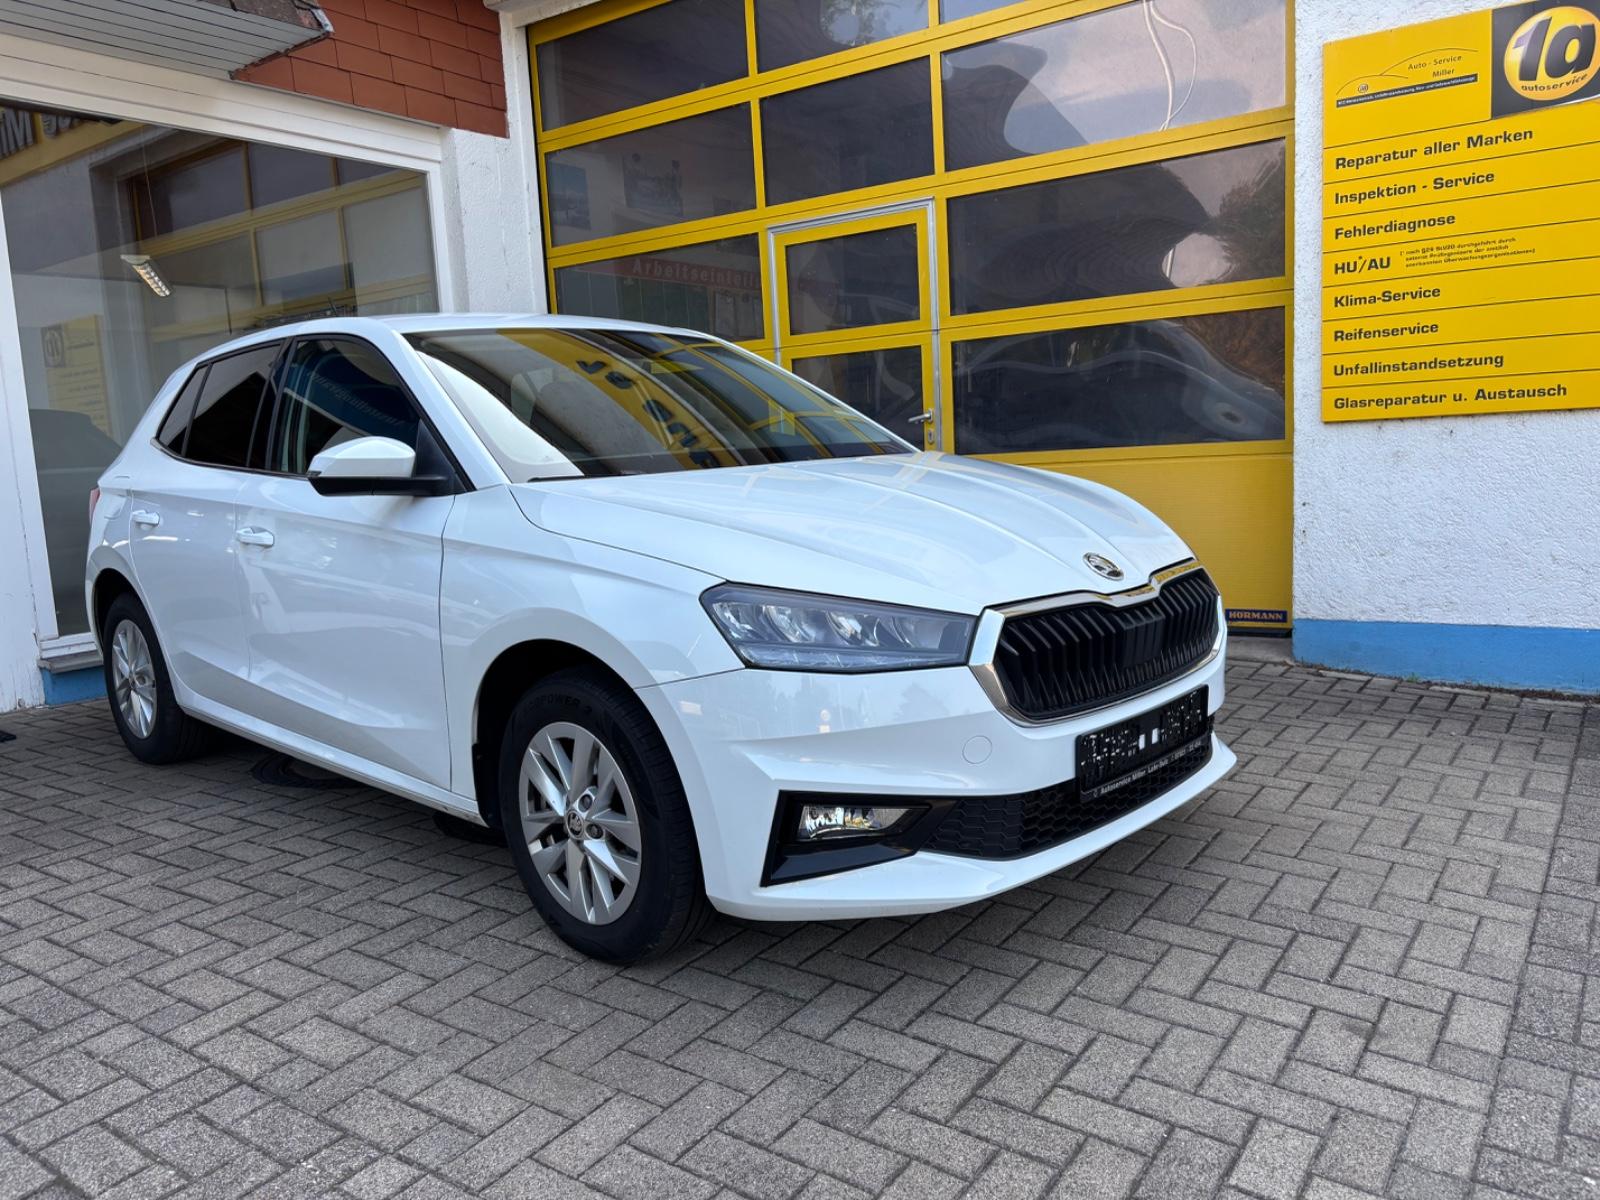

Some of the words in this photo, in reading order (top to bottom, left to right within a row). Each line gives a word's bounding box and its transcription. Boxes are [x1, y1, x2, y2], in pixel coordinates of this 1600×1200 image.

[1408, 62, 1427, 70] Auto
[1433, 55, 1462, 65] Service
[1432, 68, 1455, 78] Miller
[1521, 73, 1588, 91] autoservice
[1335, 148, 1418, 170] Reparatur
[1424, 141, 1461, 156] aller
[1467, 130, 1534, 149] Marken
[1335, 183, 1416, 204] Inspektion
[1433, 172, 1495, 190] Service
[1335, 215, 1456, 239] Fehlerdiagnose
[632, 258, 758, 287] Arbeitseinteil
[1334, 287, 1441, 308] Klima-Service
[1334, 322, 1439, 342] Reifenservice
[1333, 354, 1504, 376] Unfallinstandsetzung
[1334, 390, 1447, 410] Glasreparatur
[1452, 392, 1467, 402] u.
[1474, 384, 1567, 401] Austausch
